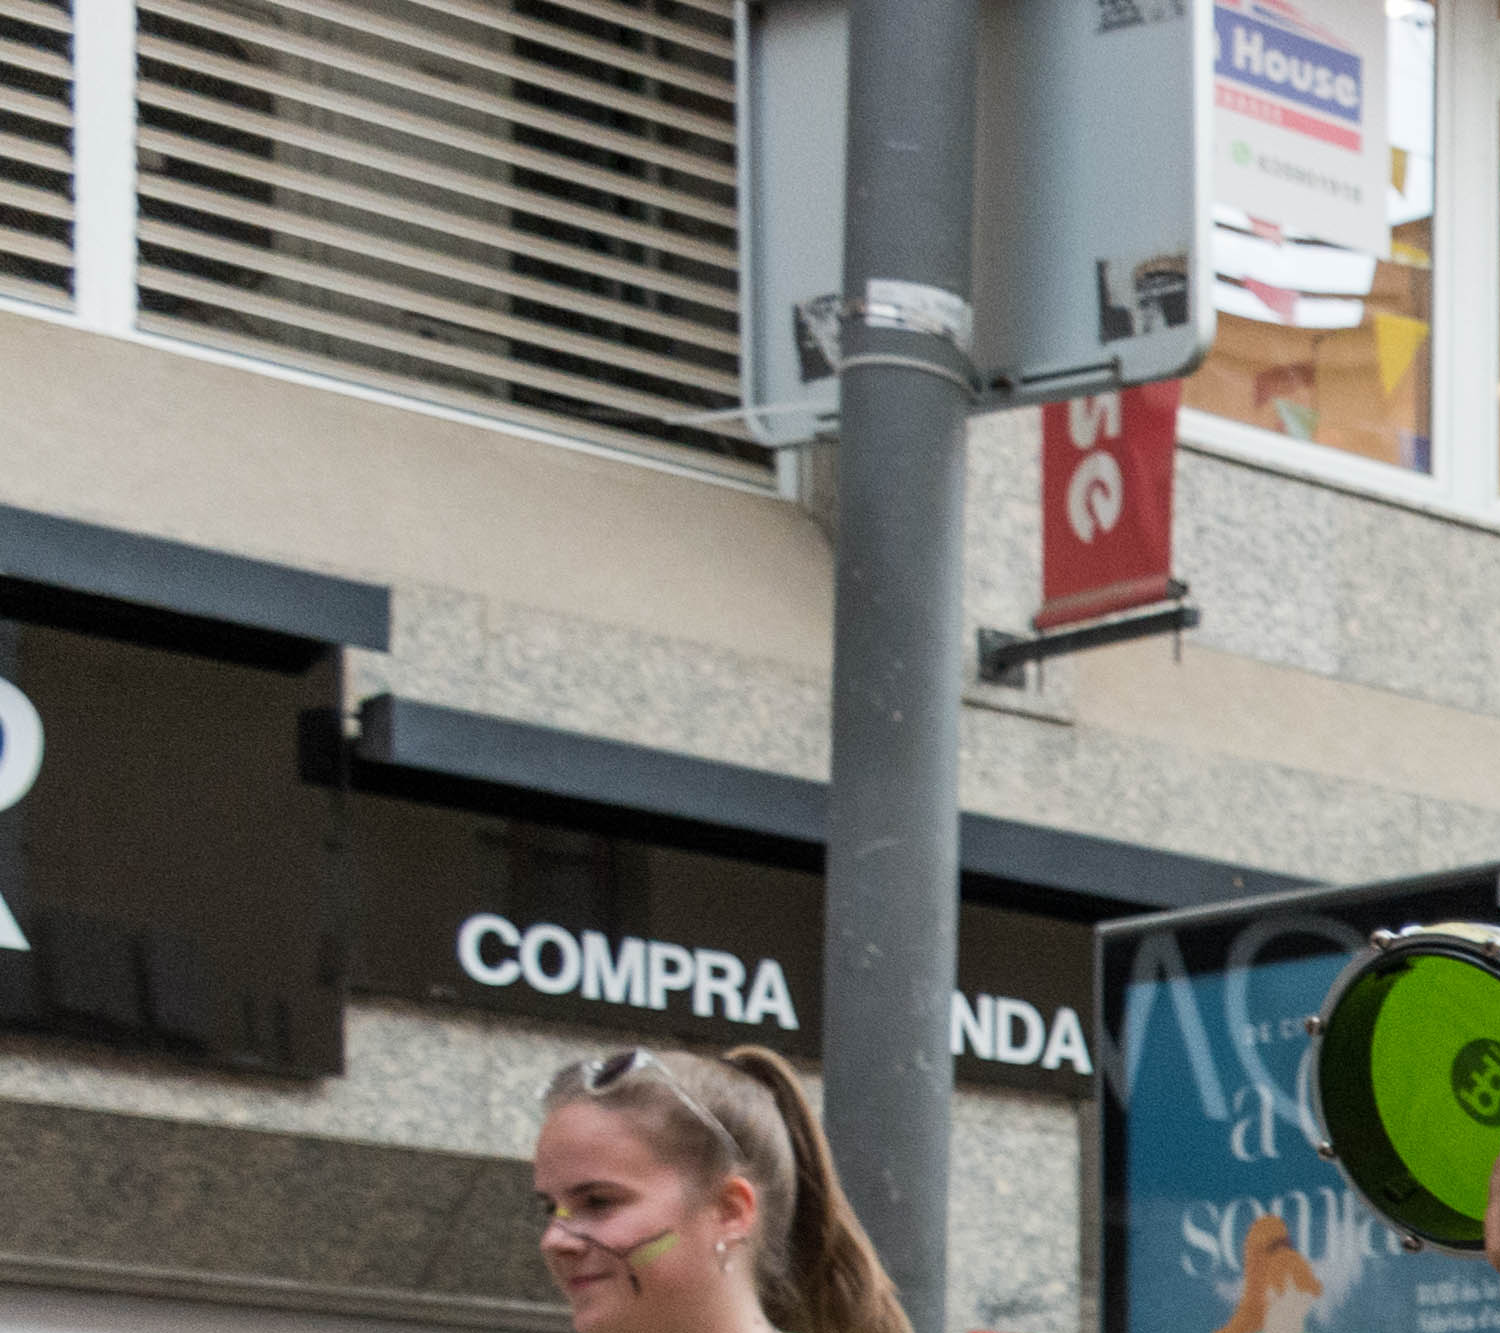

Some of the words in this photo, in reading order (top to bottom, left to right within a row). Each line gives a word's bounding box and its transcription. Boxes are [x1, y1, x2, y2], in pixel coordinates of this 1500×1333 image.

[1232, 25, 1359, 107] House
[456, 912, 800, 1031] COMPRA
[951, 989, 1094, 1076] NDA
